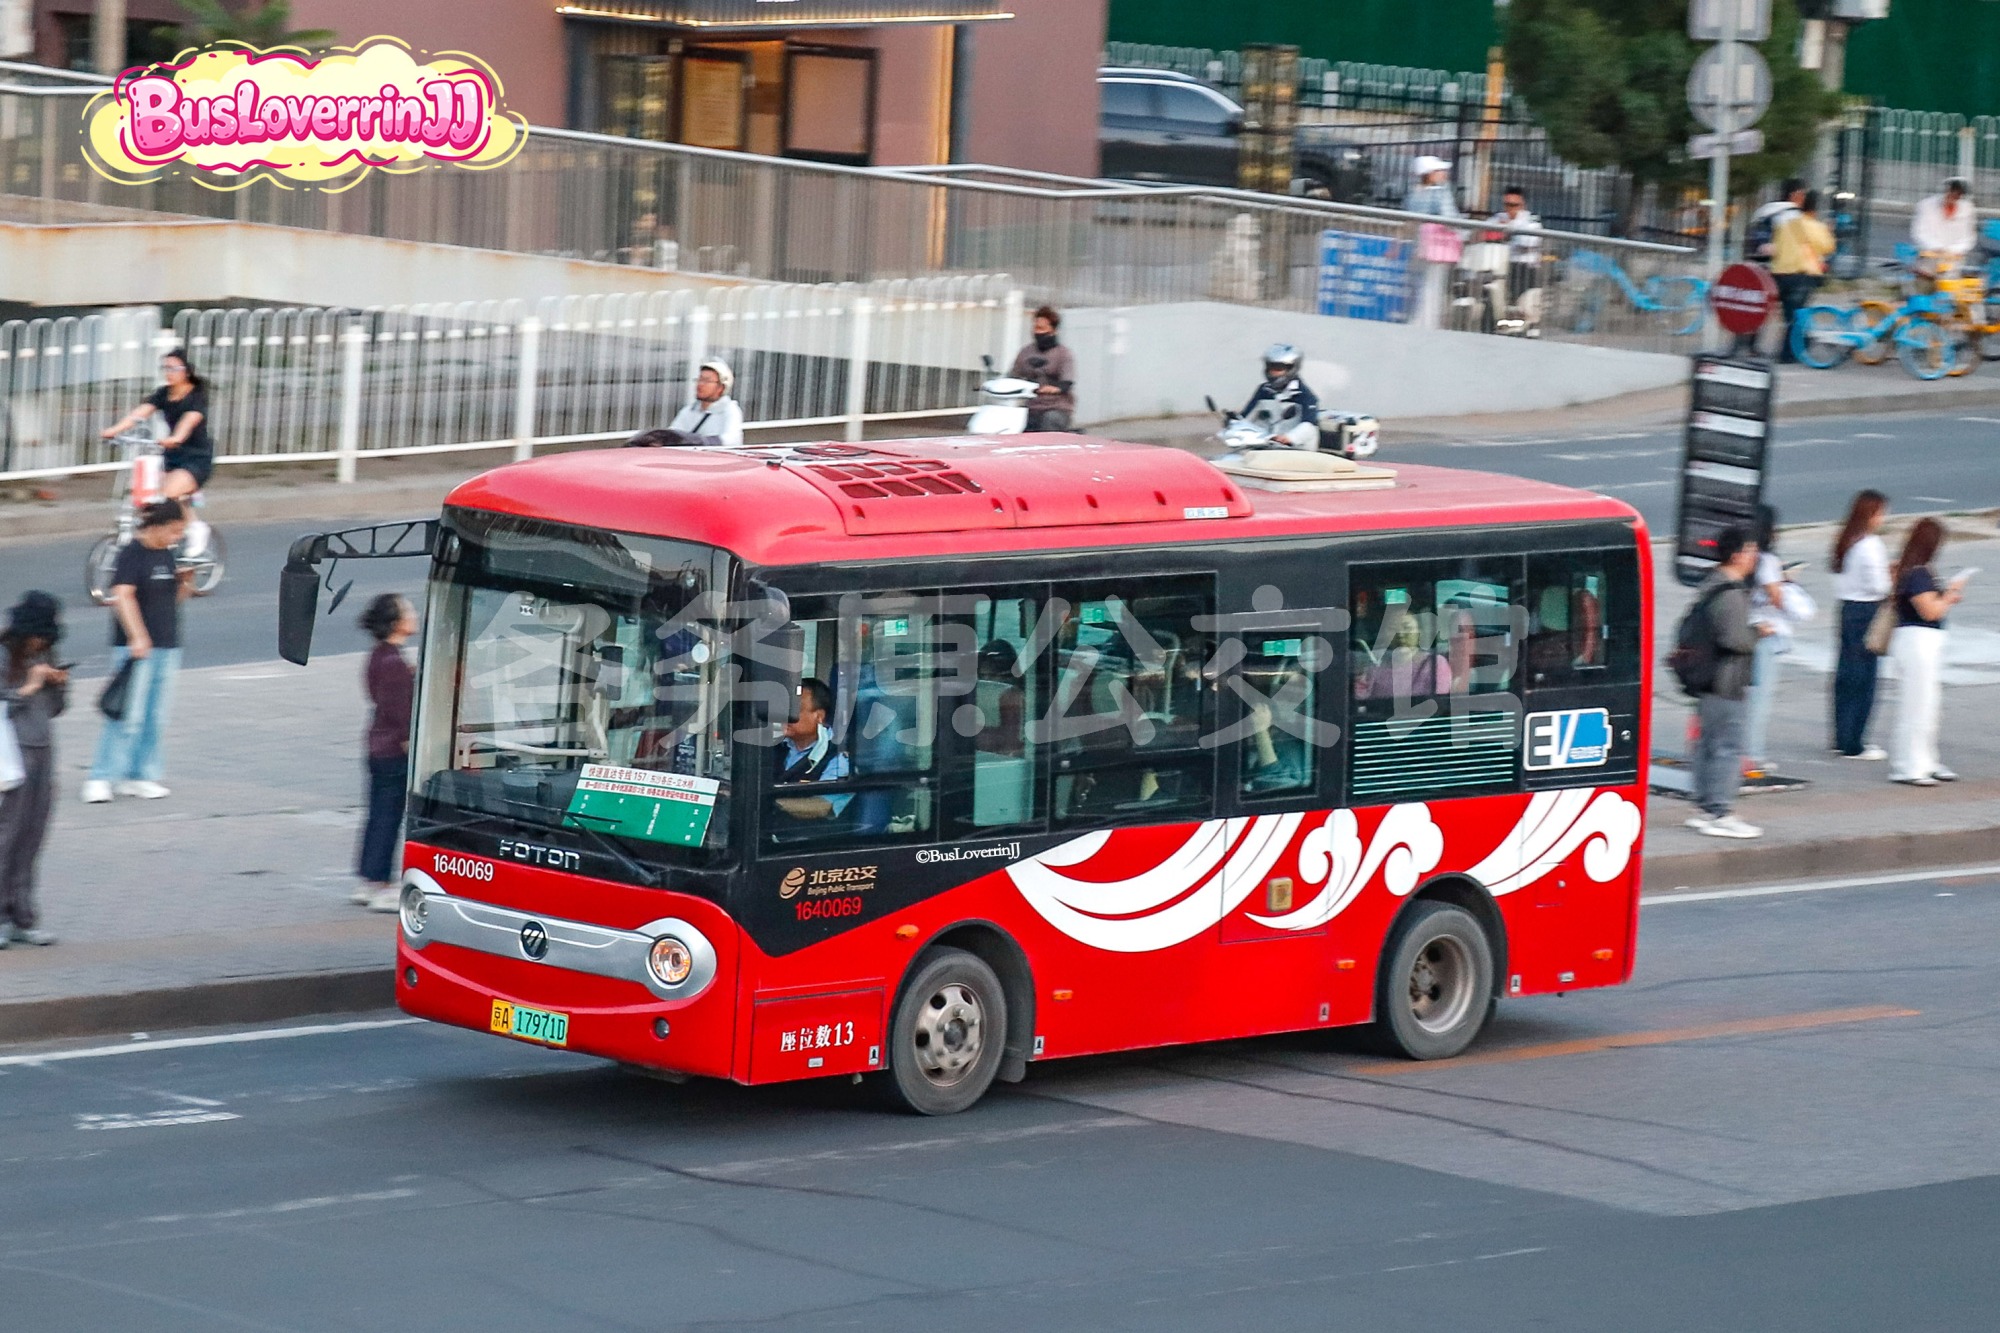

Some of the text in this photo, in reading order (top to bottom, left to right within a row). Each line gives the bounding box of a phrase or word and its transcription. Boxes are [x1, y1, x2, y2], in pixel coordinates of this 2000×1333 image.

[433, 853, 494, 882] 1640069
[499, 839, 581, 870] FOTON
[808, 866, 877, 885] 北京公交
[795, 897, 863, 920] 1640069
